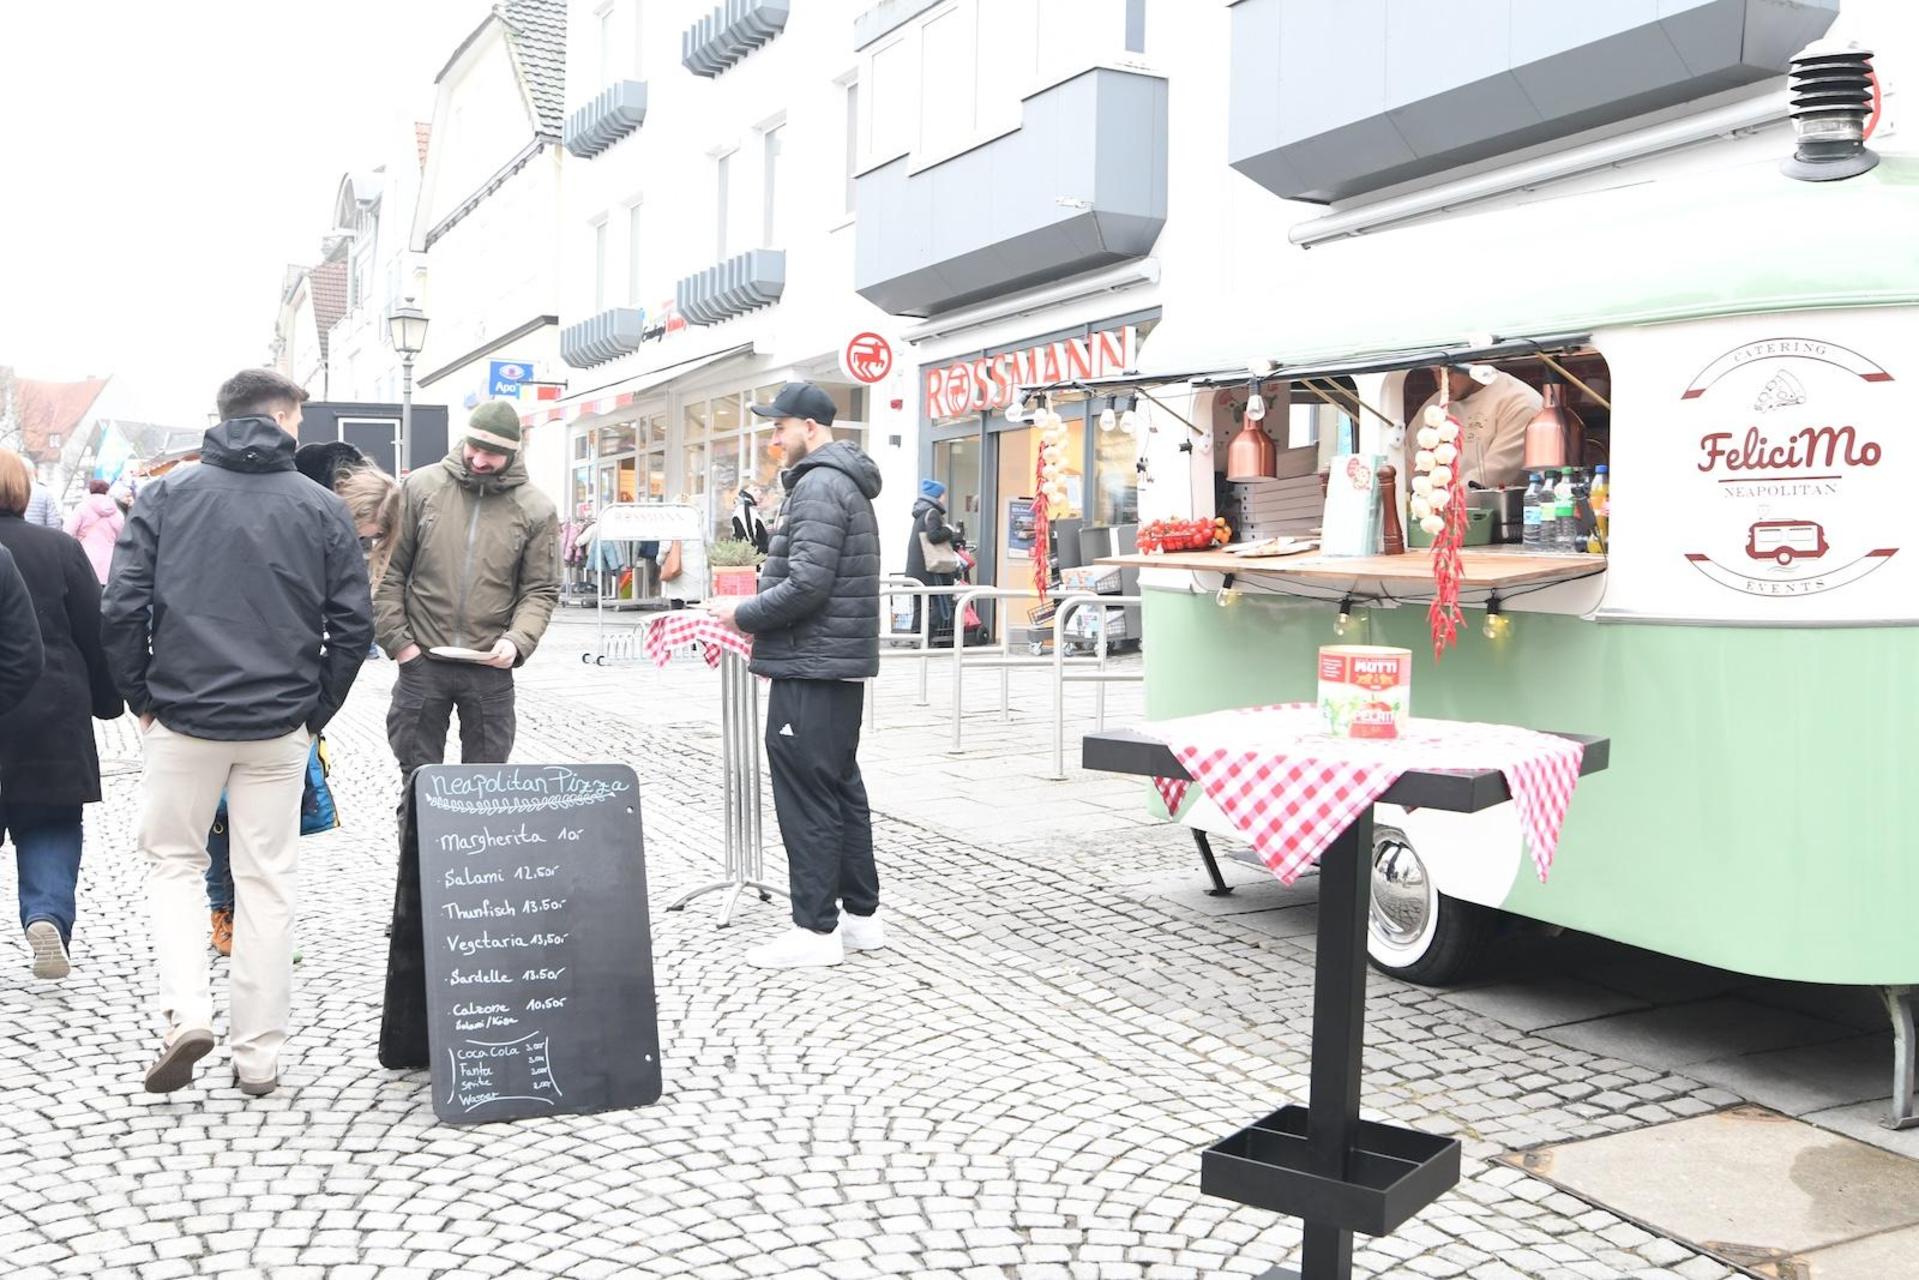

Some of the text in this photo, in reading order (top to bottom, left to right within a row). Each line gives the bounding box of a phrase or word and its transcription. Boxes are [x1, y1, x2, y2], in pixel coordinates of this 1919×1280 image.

[1733, 342, 1827, 362] CATERING
[926, 325, 1136, 418] ROSSMANN
[495, 381, 520, 393] Apo
[1698, 425, 1882, 472] FeliciMo
[1724, 483, 1838, 498] NEAPOLITAN
[1746, 579, 1826, 594] EVENTS
[1354, 661, 1397, 673] MUTTI
[544, 766, 630, 797] Pizza
[440, 823, 548, 855] Margherita
[445, 866, 504, 888] Salami
[442, 899, 515, 919] Thunfisch
[450, 968, 514, 986] Sardelle
[452, 1002, 510, 1016] Calzone
[490, 1046, 520, 1056] Cola
[459, 1061, 494, 1076] Fanta
